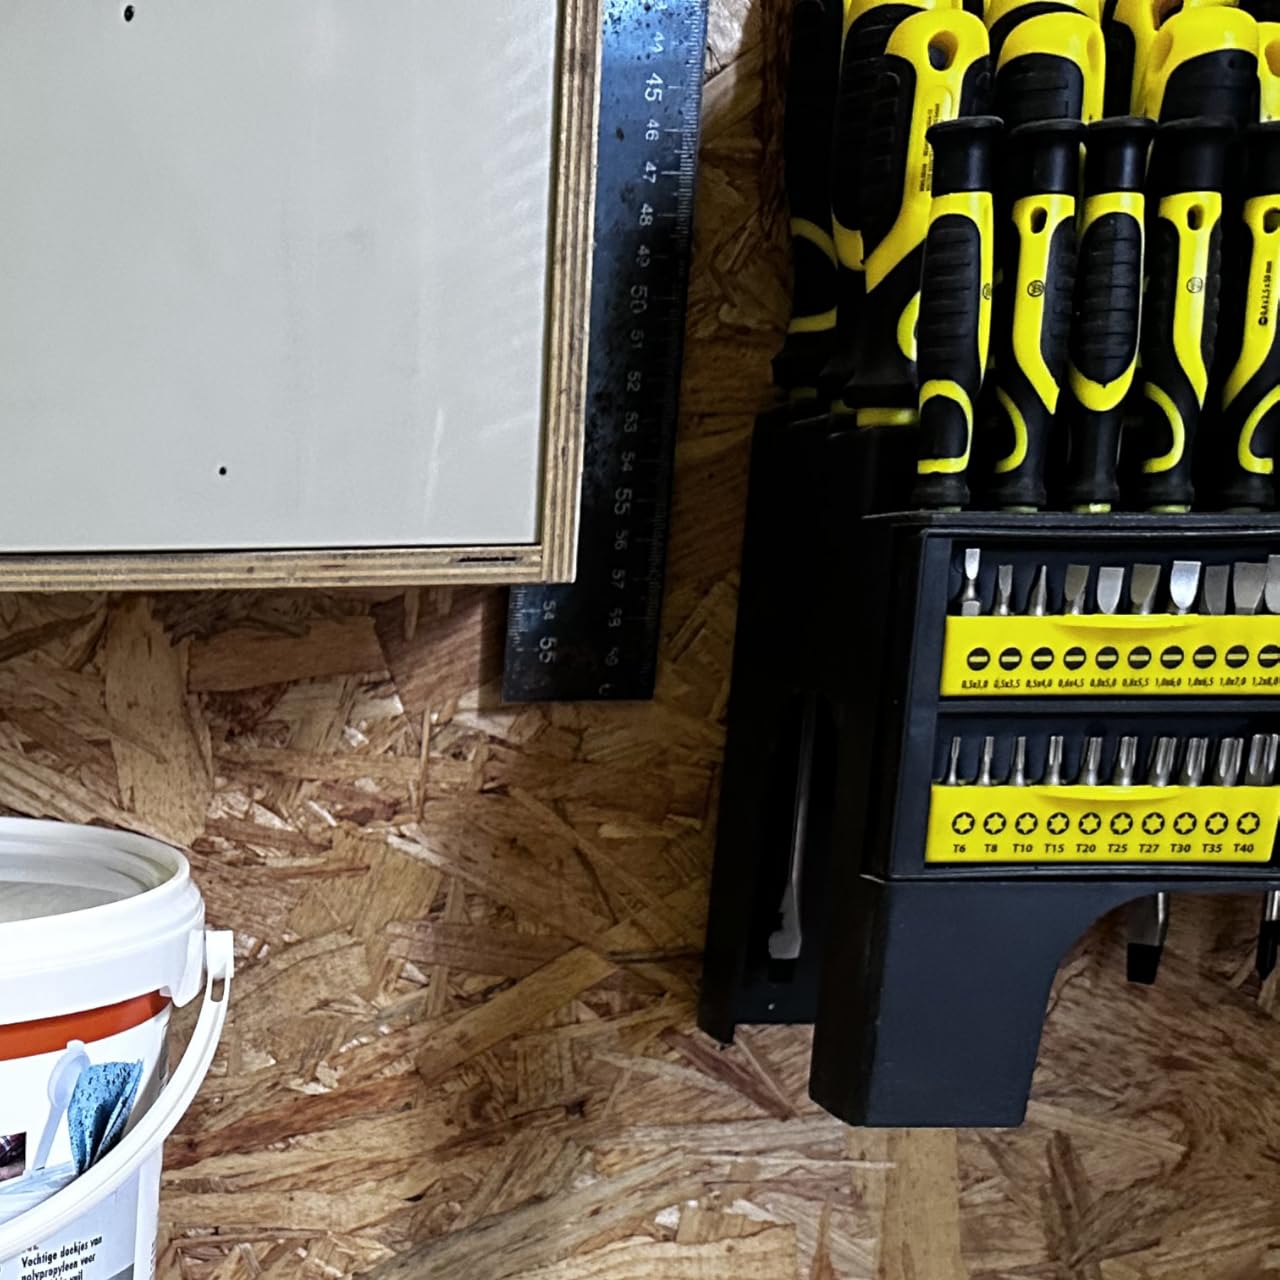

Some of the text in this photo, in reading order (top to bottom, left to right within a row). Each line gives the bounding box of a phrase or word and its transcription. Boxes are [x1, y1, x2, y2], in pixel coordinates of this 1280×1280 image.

[644, 72, 664, 102] 45
[645, 118, 660, 141] 46
[643, 160, 657, 183] 47
[639, 203, 653, 226] 48
[630, 285, 648, 314] 50
[626, 371, 641, 392] 52
[623, 411, 639, 433] 53
[615, 487, 632, 516] 55
[542, 600, 557, 621] 54
[539, 636, 557, 664] 55
[953, 844, 1254, 854] T6 T8 T10 T15 T20 T25 T27 T30 T35 T40
[21, 1251, 58, 1268] Vochtige
[60, 1241, 89, 1258] doekjes
